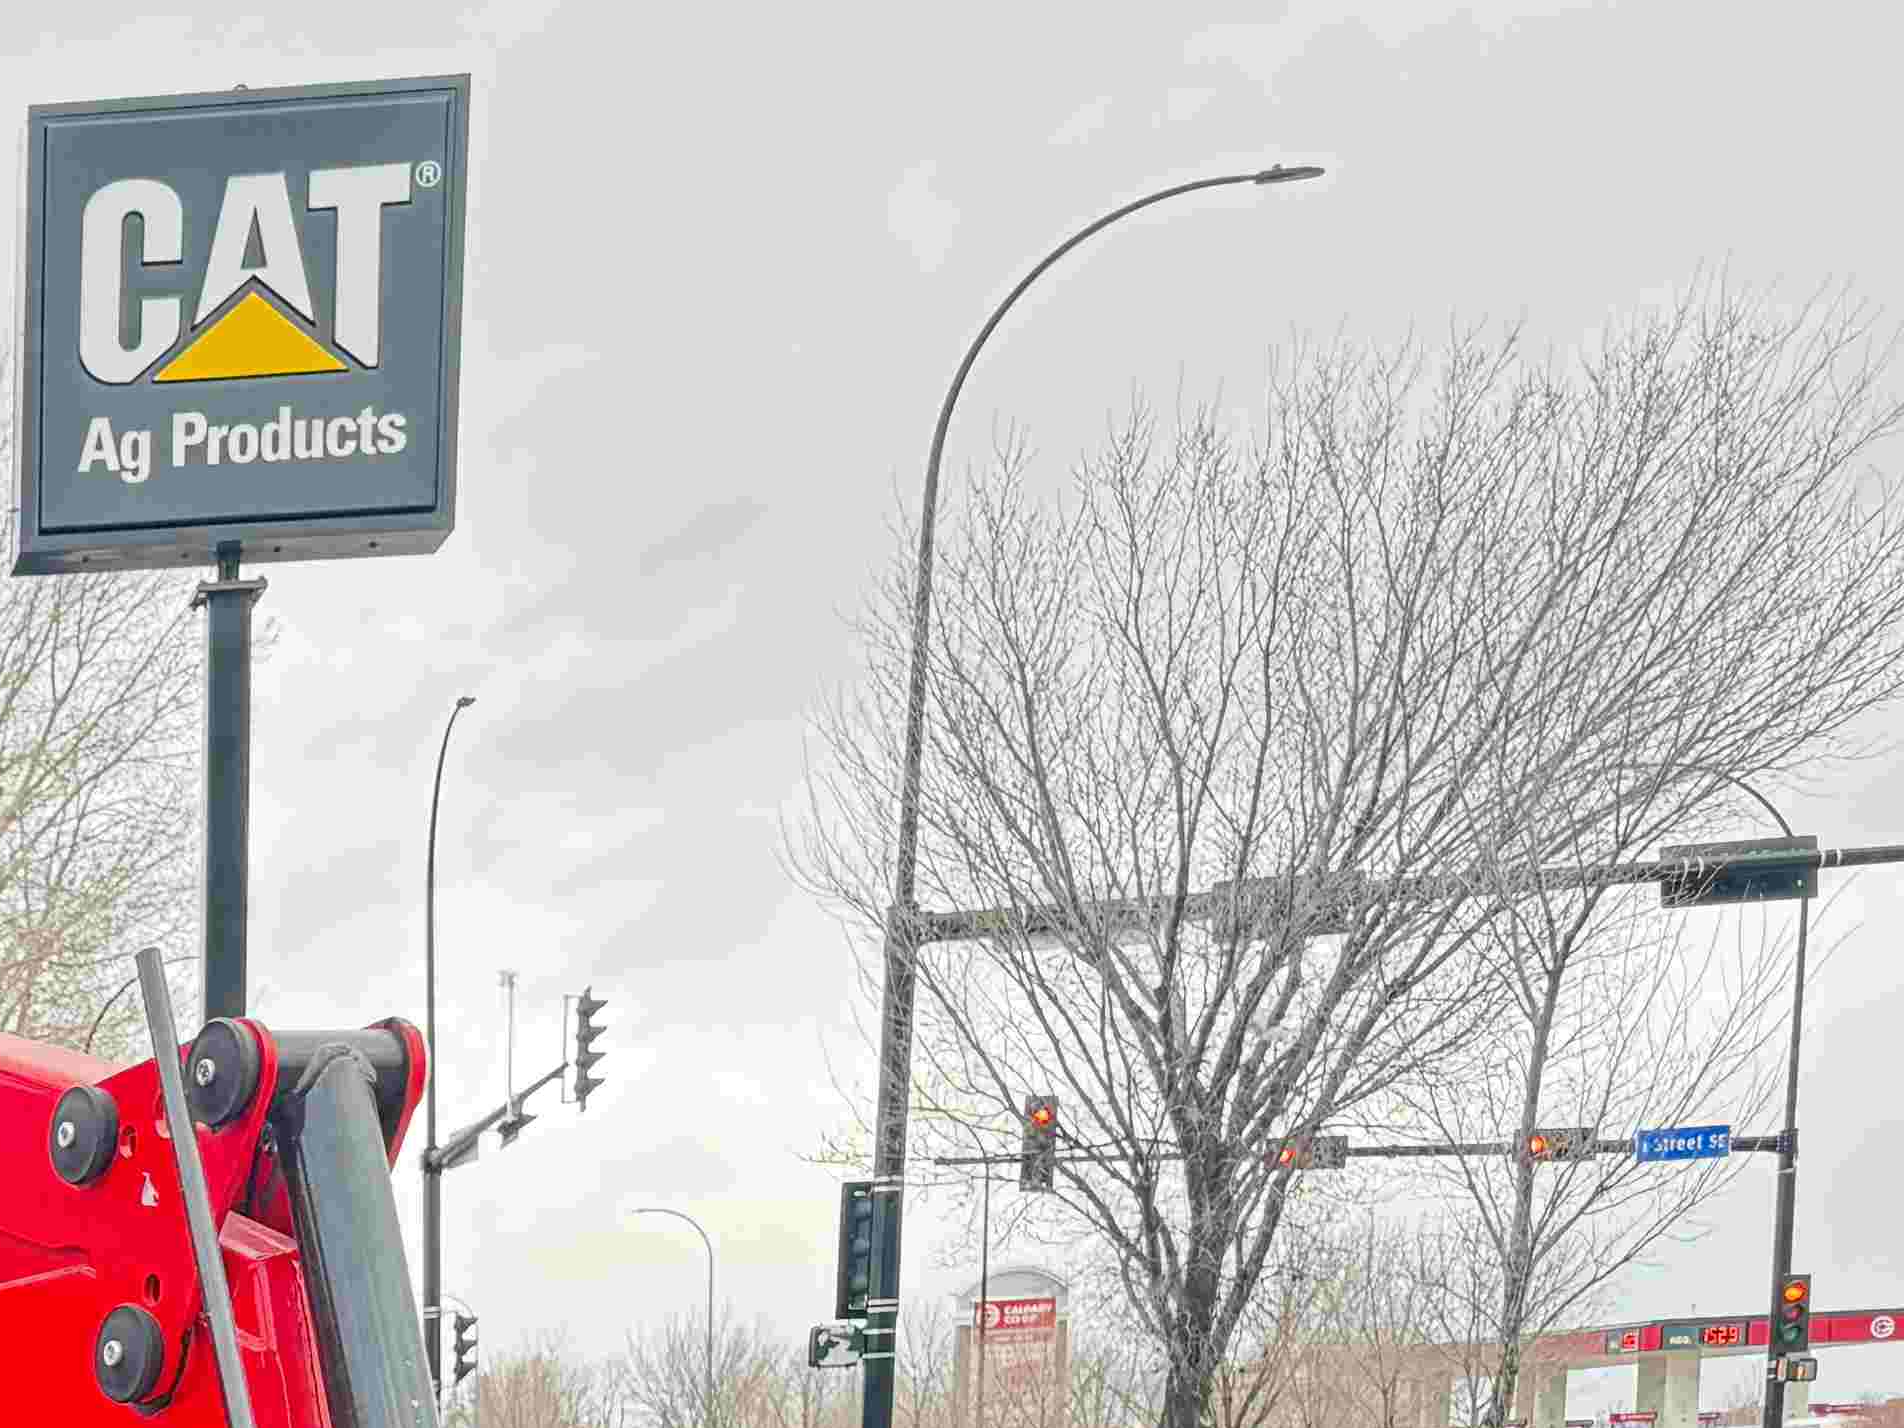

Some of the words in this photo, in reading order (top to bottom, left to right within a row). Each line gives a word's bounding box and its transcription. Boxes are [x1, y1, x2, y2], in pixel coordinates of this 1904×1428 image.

[79, 162, 413, 385] CAT
[78, 416, 152, 483] Ag
[171, 406, 408, 467] Products
[1653, 1134, 1702, 1152] Street
